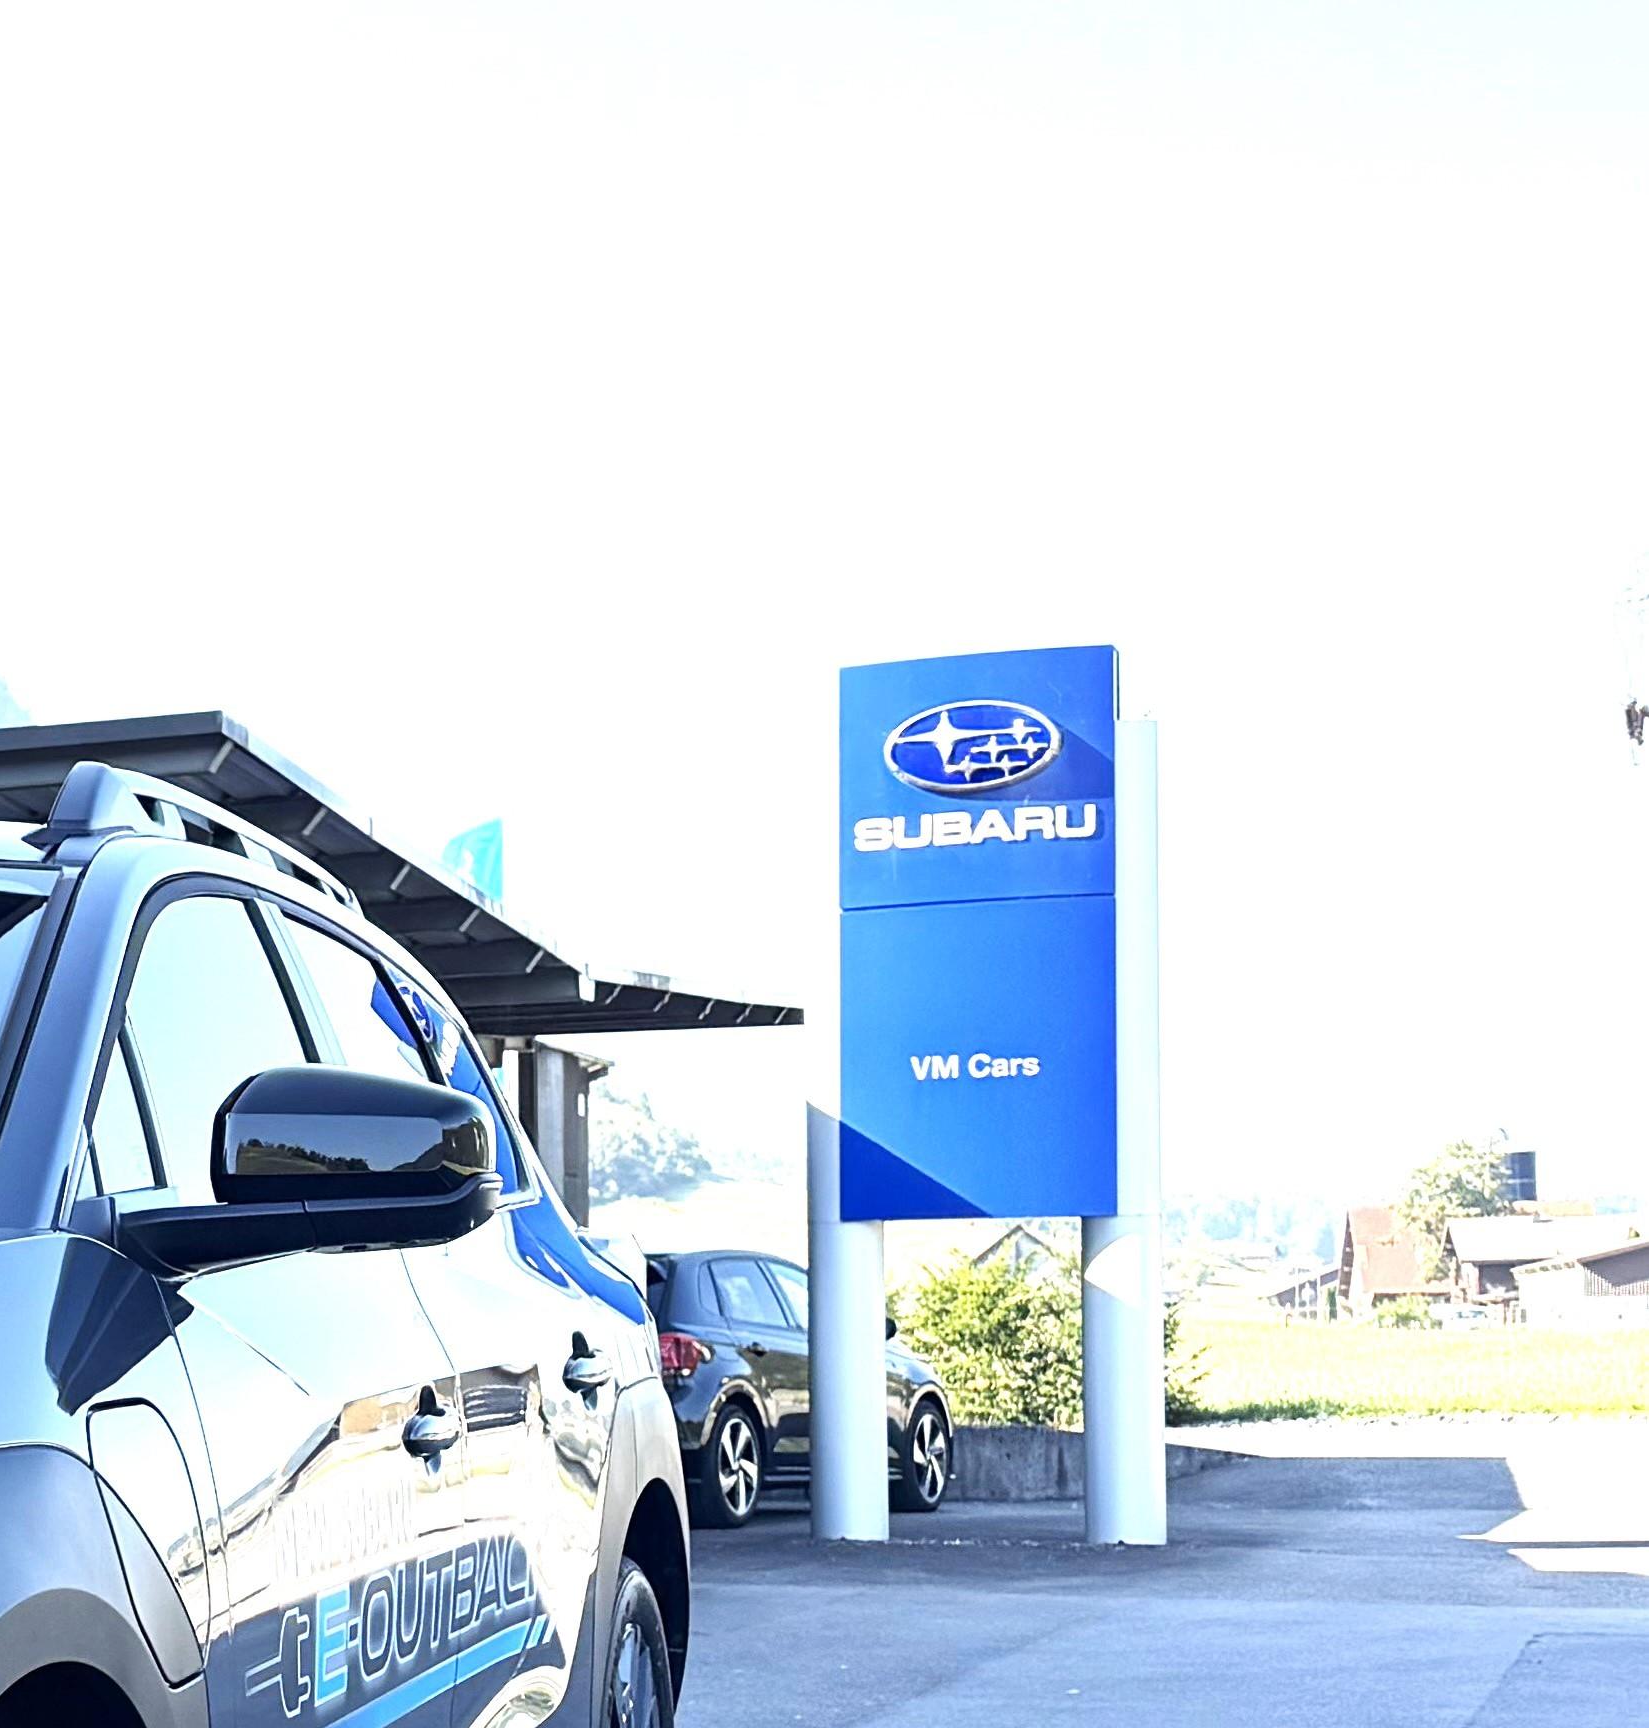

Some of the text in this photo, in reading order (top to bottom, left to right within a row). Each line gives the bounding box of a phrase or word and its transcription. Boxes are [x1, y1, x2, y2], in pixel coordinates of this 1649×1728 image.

[853, 803, 1097, 852] SUBARU
[909, 1053, 1041, 1081] VM Cars
[314, 1533, 537, 1708] E-OUTBAC
